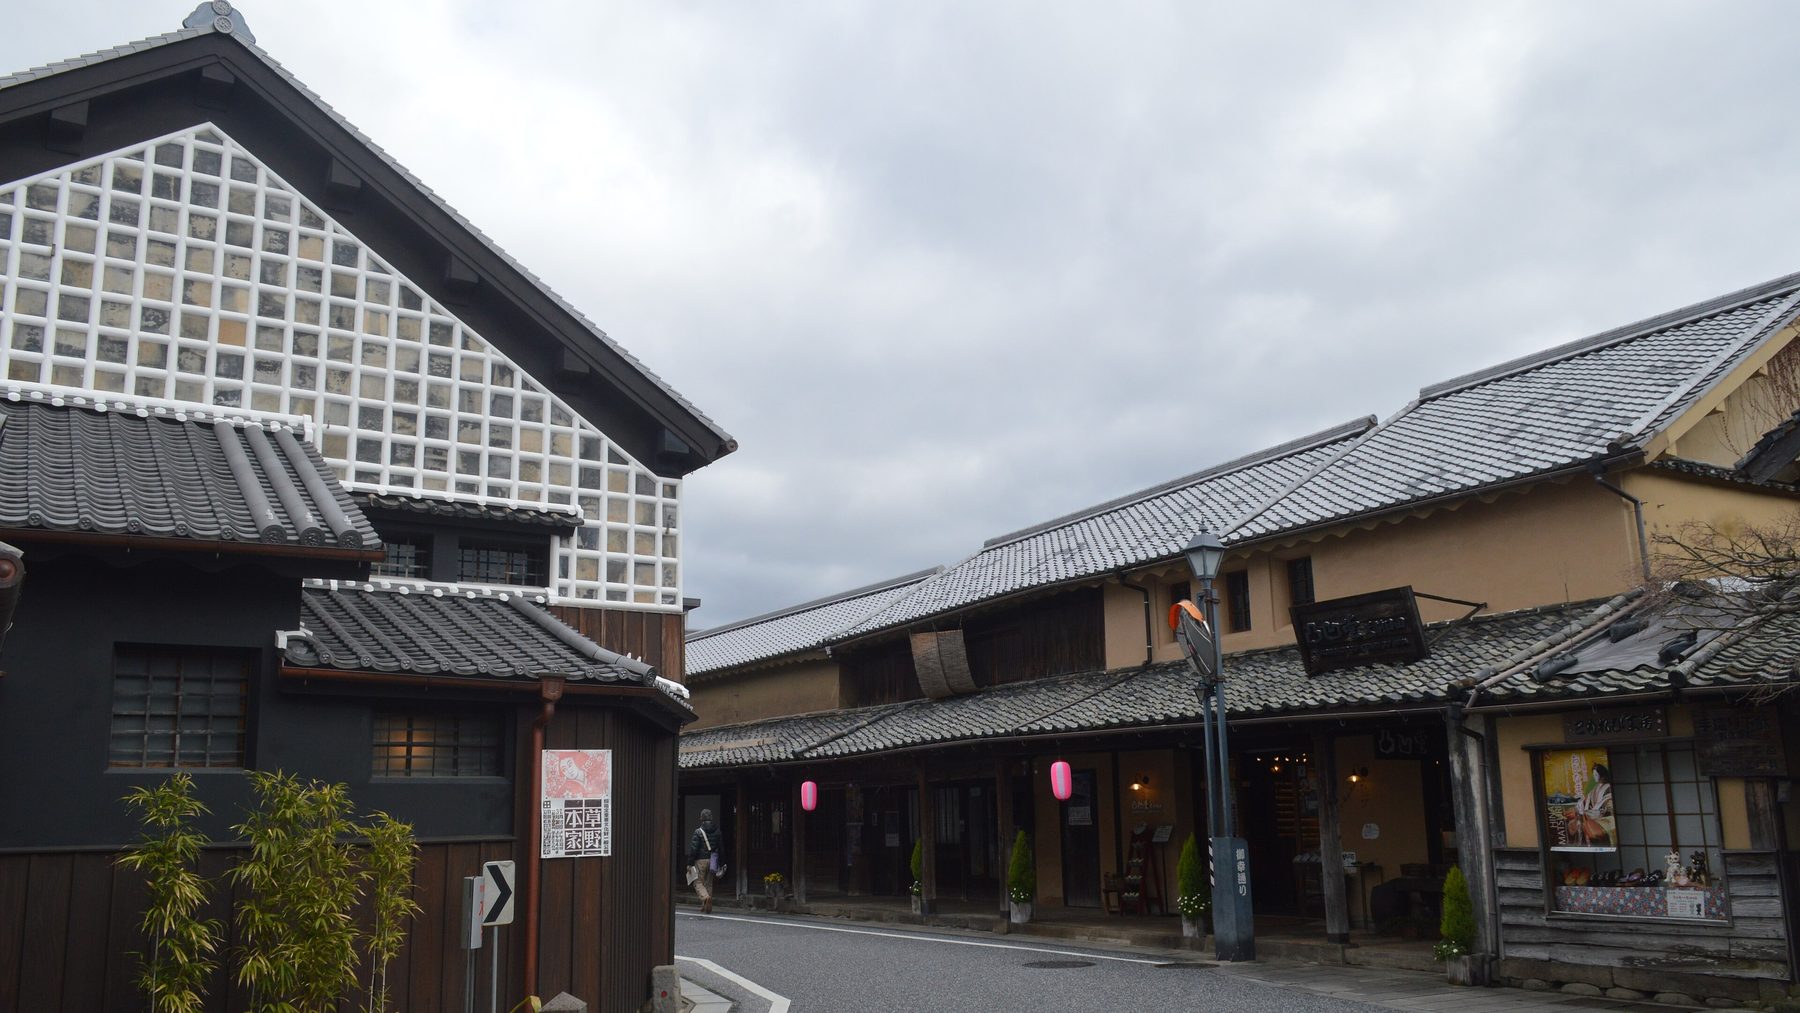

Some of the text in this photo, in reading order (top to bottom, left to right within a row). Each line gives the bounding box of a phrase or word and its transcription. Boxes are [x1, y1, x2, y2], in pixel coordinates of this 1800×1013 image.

[564, 808, 583, 849] 本家
[584, 808, 602, 849] 草野
[1548, 806, 1558, 828] HINA
[1236, 848, 1247, 896] 御幸通り
